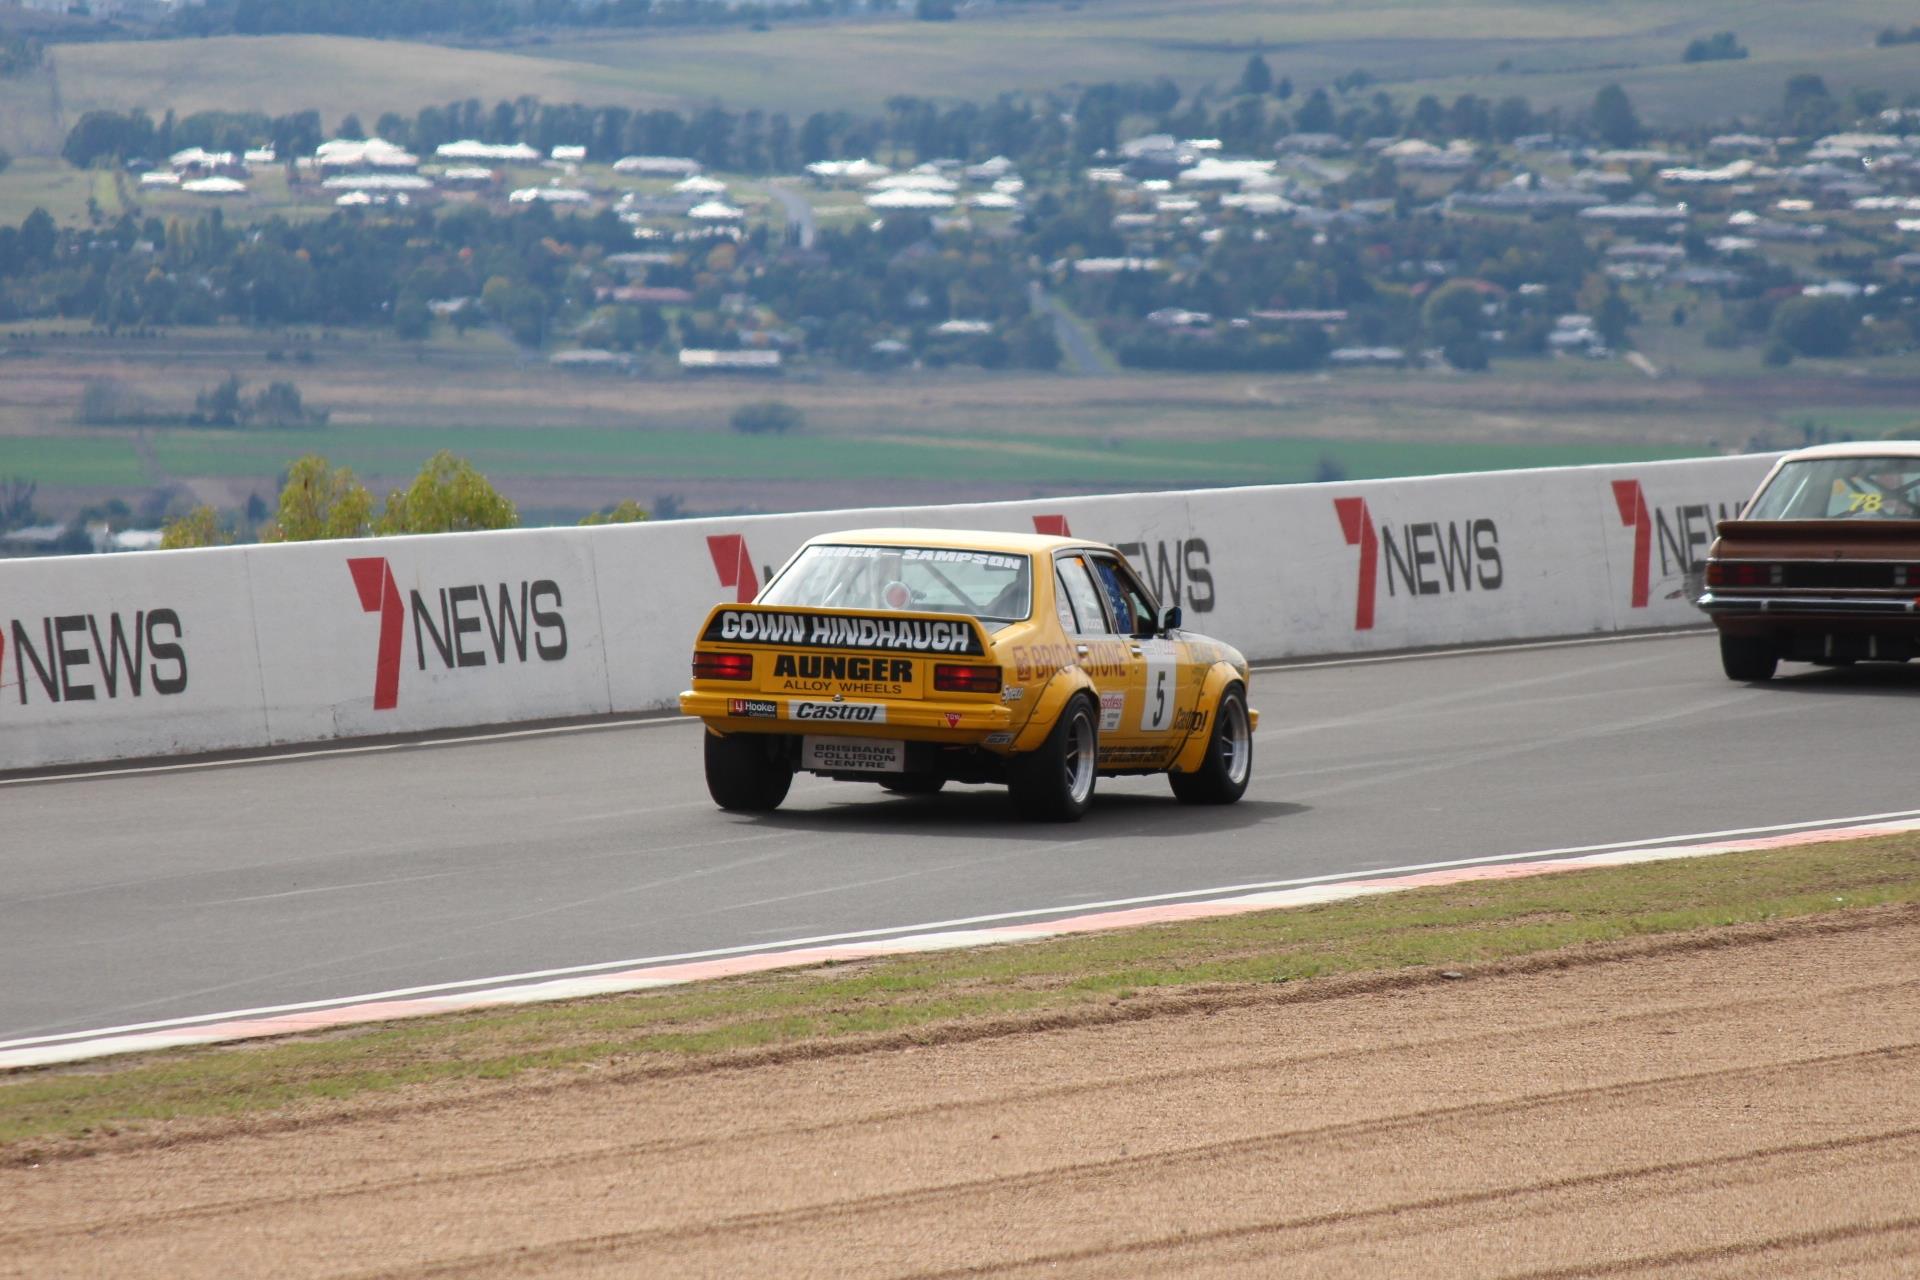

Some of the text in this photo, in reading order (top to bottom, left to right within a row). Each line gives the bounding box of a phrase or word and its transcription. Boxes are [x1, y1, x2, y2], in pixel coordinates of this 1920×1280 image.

[1847, 493, 1882, 512] 78
[1656, 500, 1749, 576] NE
[902, 549, 1022, 570] SAMPSON
[1382, 518, 1503, 597] NEWS
[410, 579, 568, 670] NEWS
[721, 611, 969, 652] GOWN HINDHAUGH
[11, 608, 188, 705] NEWS
[774, 655, 913, 682] AUNGER
[783, 680, 902, 695] ALLOY WHEELS
[745, 701, 775, 712] Hooker
[1153, 671, 1165, 727] 5
[796, 702, 878, 721] Castrol
[814, 752, 896, 762] COLLISION
[815, 744, 895, 755] BRISBANE
[824, 760, 886, 769] CENTRE
